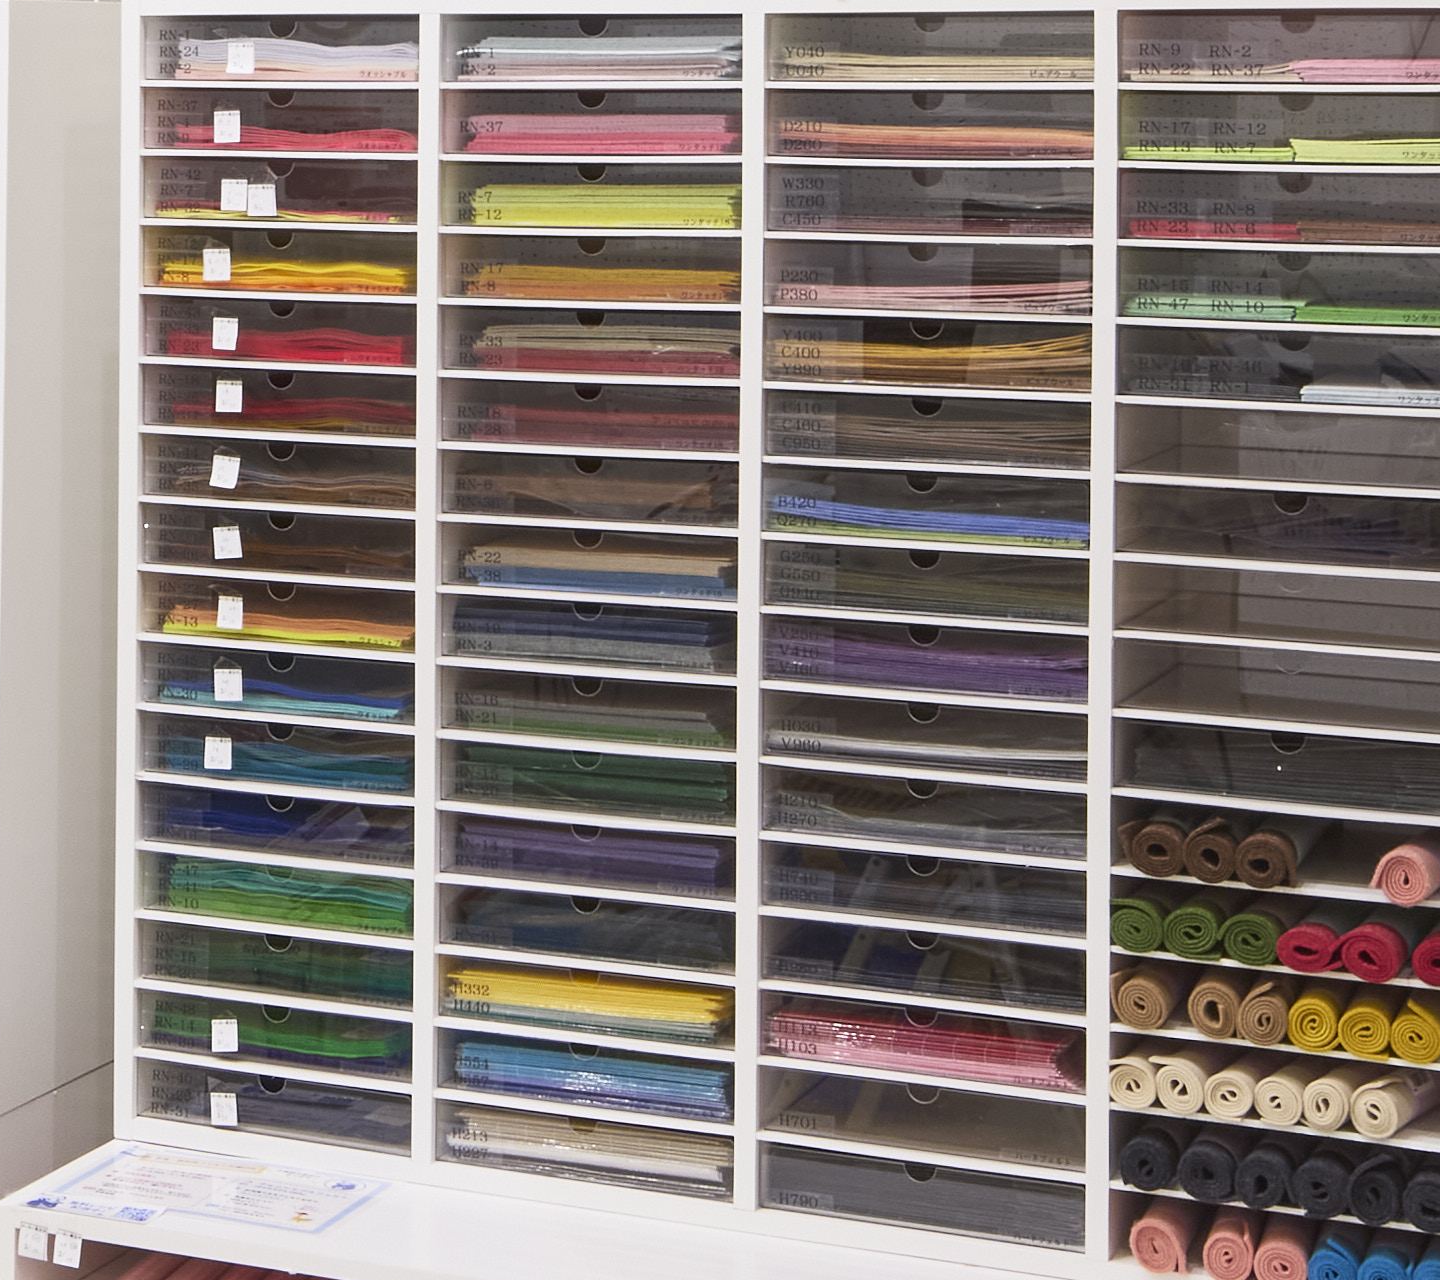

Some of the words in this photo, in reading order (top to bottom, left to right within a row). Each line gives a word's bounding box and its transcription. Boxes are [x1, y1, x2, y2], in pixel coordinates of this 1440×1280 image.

[159, 46, 199, 57] RN-24
[1139, 43, 1181, 57] RN-9
[1208, 45, 1252, 58] RN-2
[1139, 62, 1190, 76] RN-22
[1213, 122, 1266, 136] RN-12
[1212, 202, 1256, 216] RN-8
